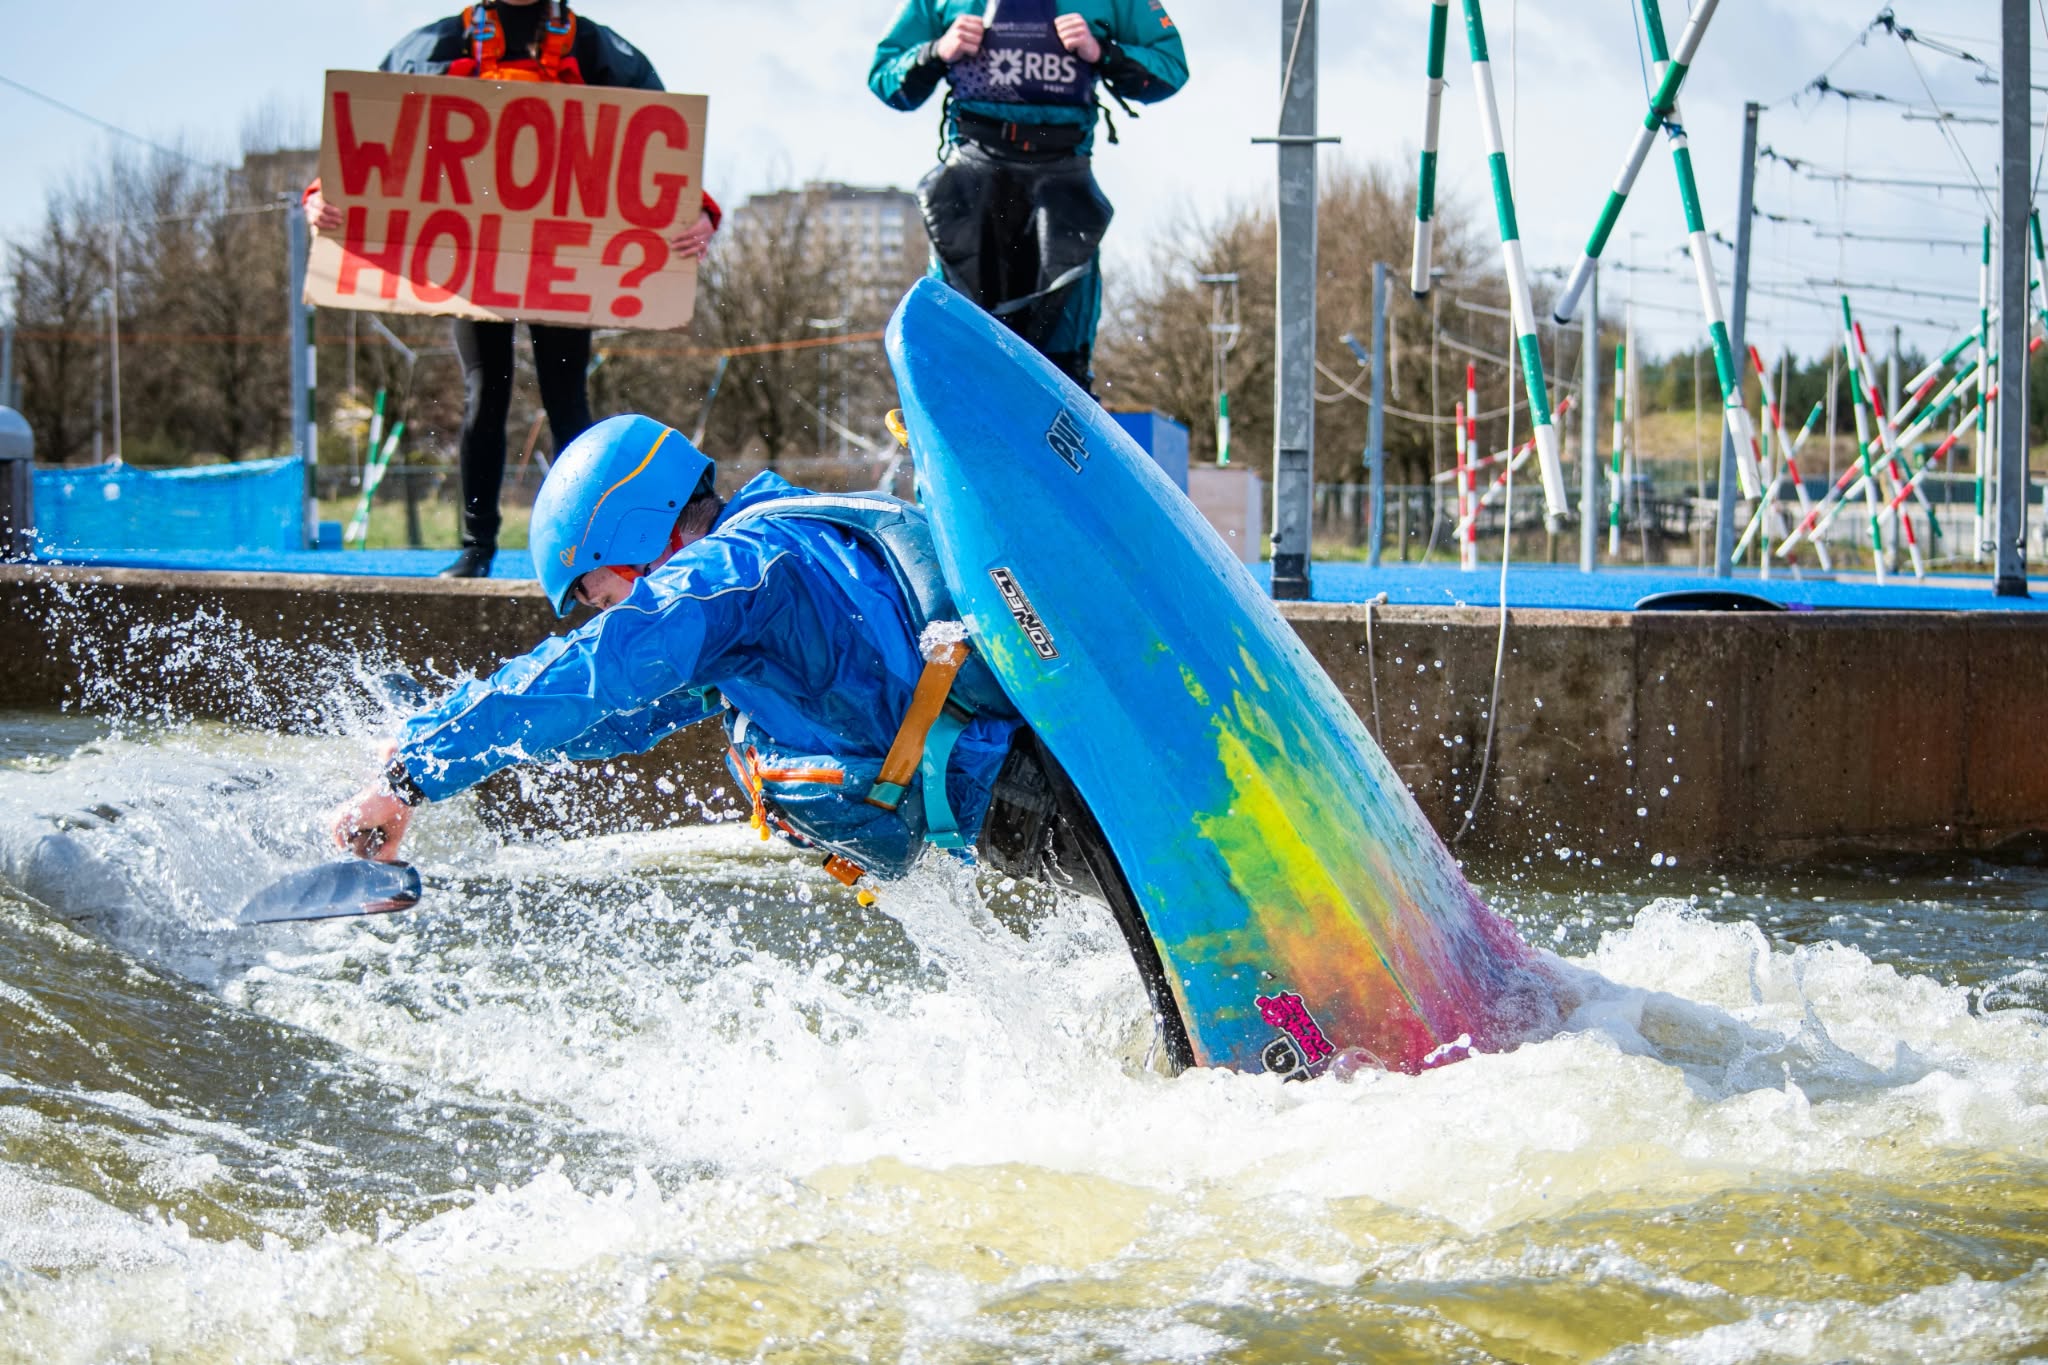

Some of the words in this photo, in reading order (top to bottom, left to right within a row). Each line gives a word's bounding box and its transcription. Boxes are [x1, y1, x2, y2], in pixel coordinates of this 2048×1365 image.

[1024, 52, 1077, 84] RBS
[333, 91, 689, 230] WRONG
[336, 205, 670, 319] HOLE?
[992, 571, 1055, 657] CONNECT
[1284, 997, 1332, 1054] monkey
[1285, 1018, 1321, 1064] kayak
